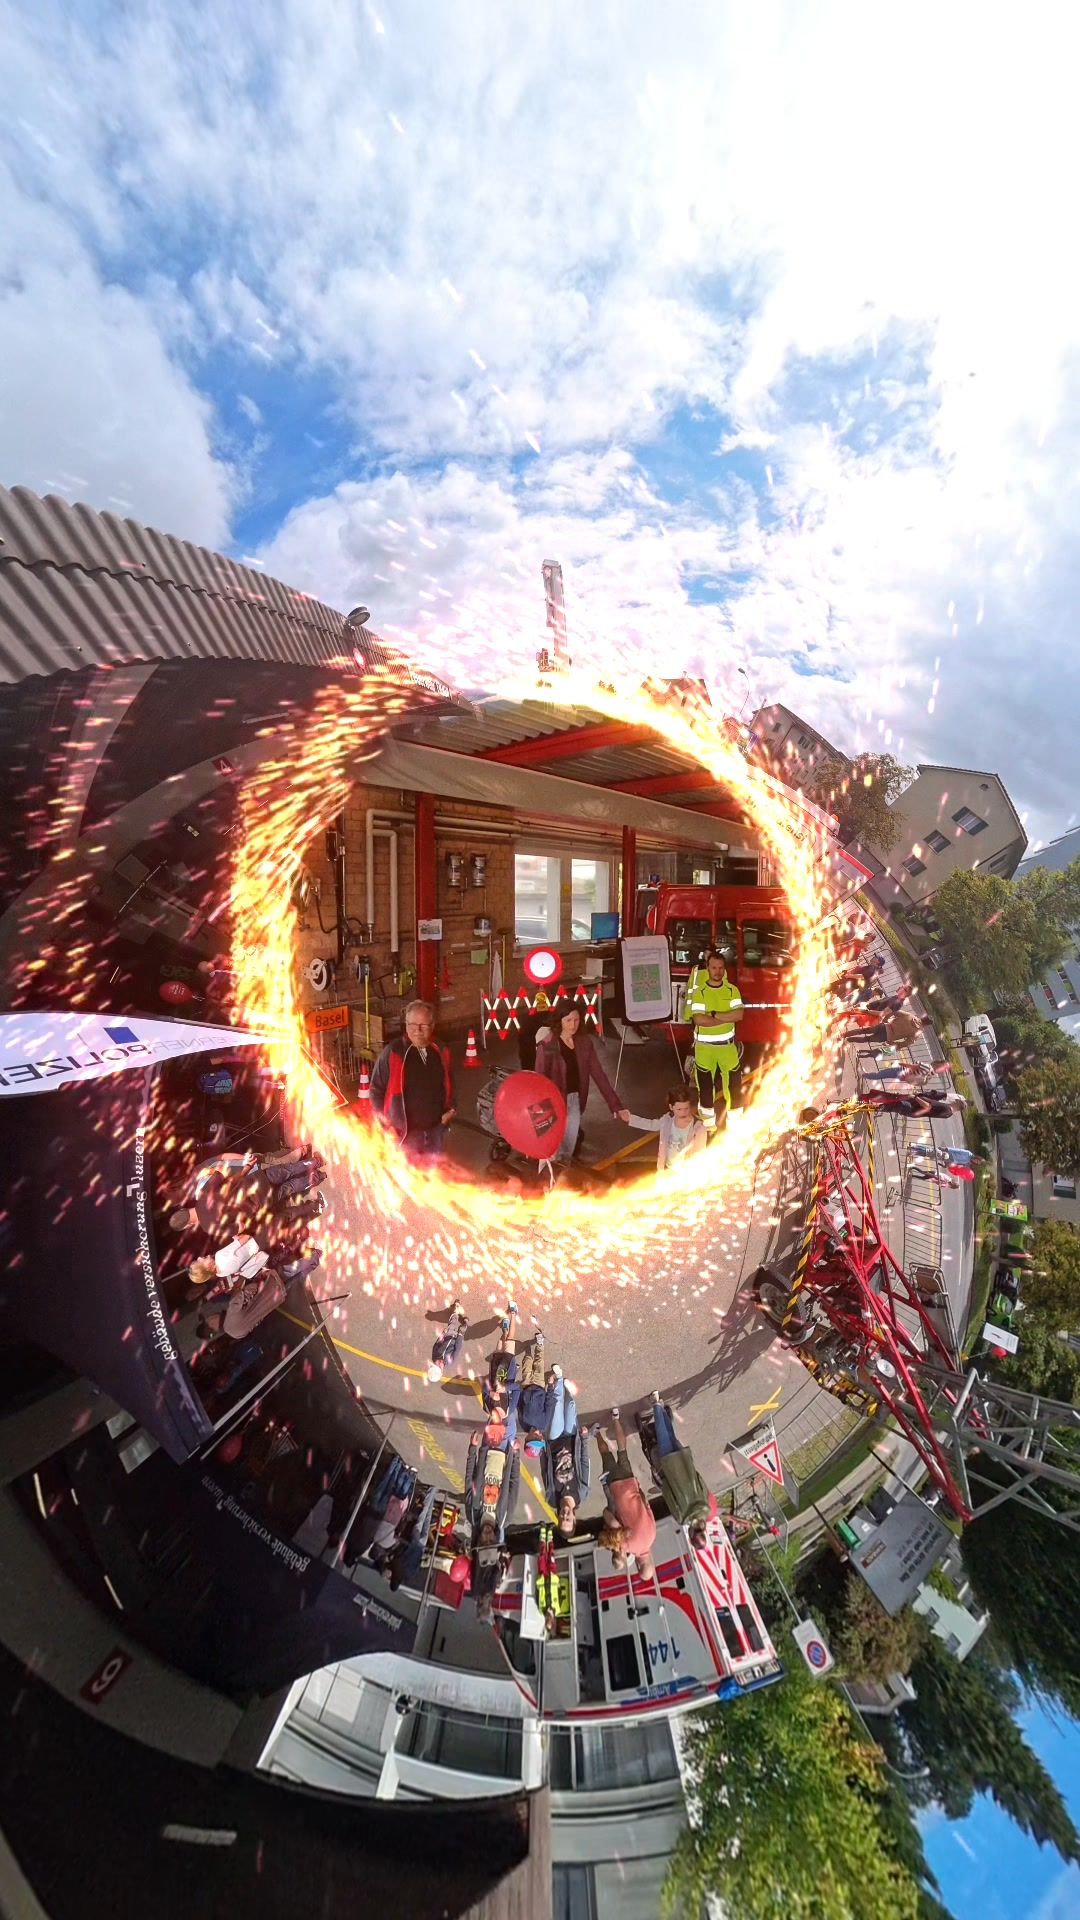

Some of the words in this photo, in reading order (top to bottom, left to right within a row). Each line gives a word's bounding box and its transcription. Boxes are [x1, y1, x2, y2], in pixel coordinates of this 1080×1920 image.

[315, 1008, 345, 1028] Basel
[135, 1191, 157, 1298] versicherung
[147, 1299, 178, 1361] gebäude
[271, 1536, 311, 1573] gebäude
[649, 1636, 680, 1666] 144
